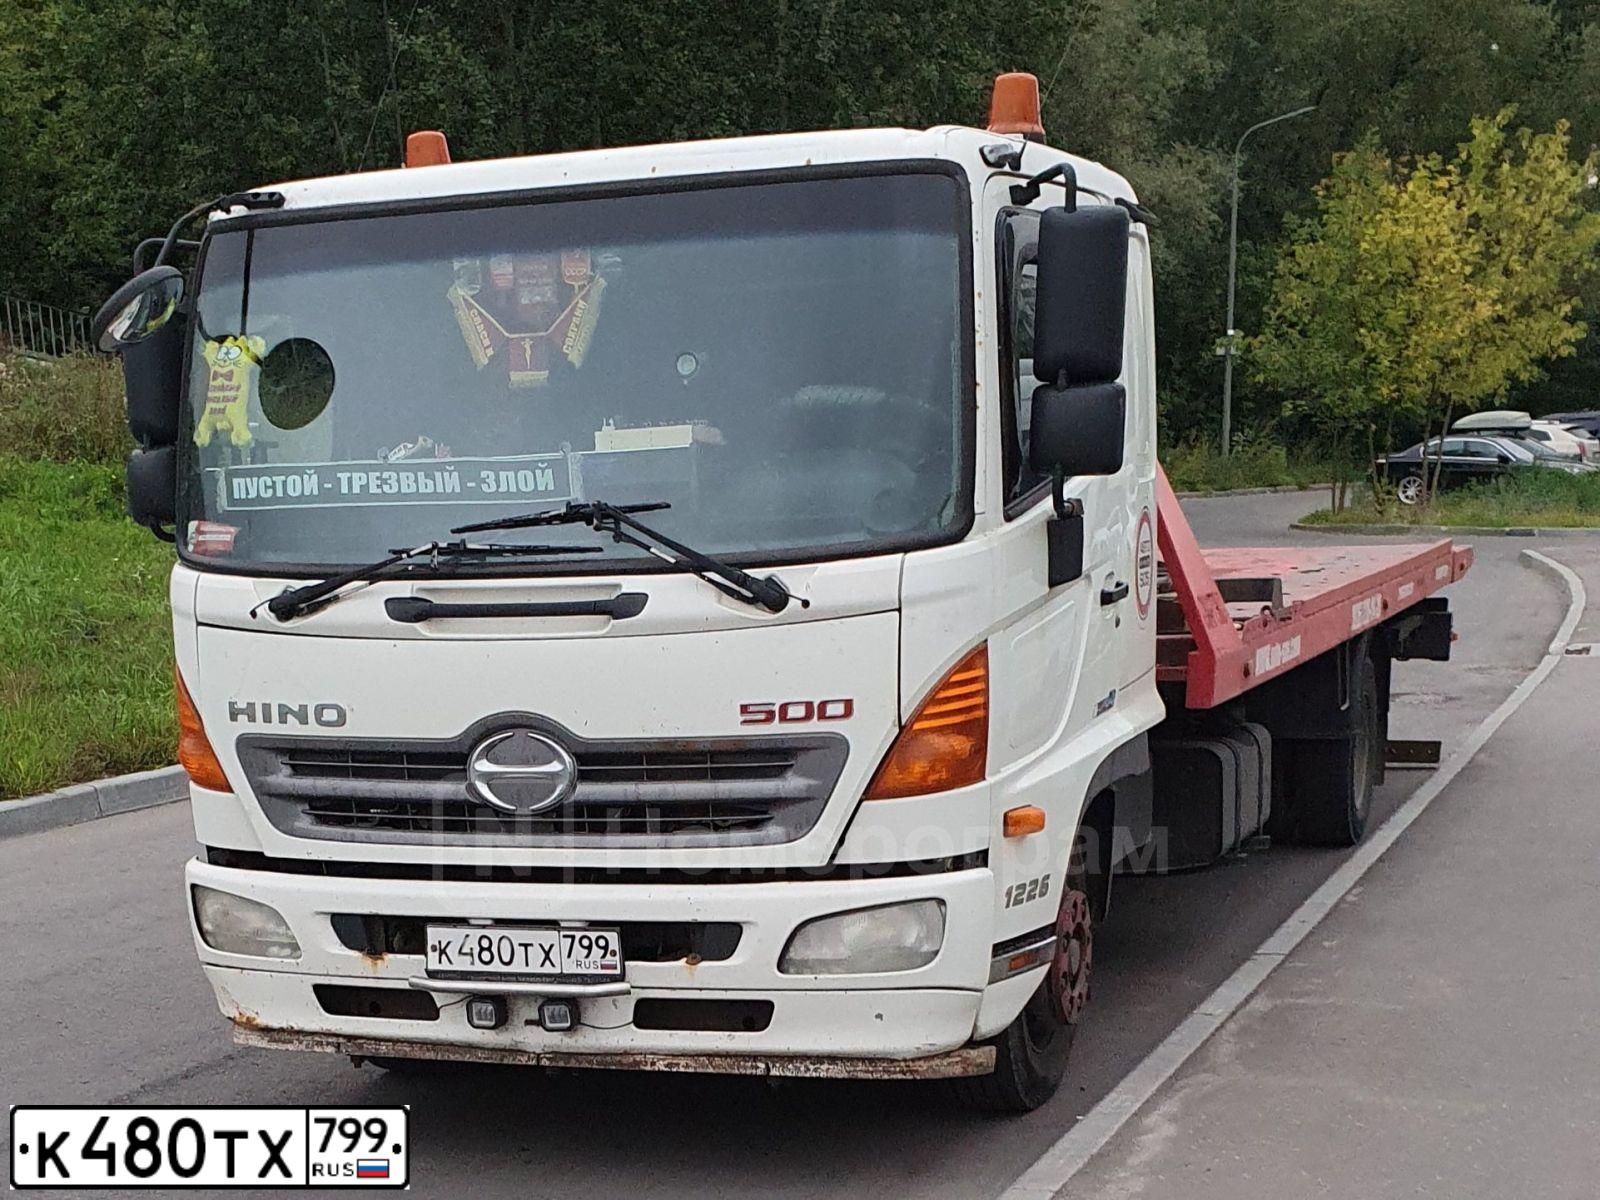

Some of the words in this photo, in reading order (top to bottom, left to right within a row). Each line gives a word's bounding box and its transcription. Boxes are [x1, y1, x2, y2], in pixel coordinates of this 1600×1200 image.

[232, 469, 319, 499] ПУСТОЙ
[336, 465, 461, 494] ТРЕЗВЫЙ
[480, 462, 555, 492] ЗЛОЙ
[228, 701, 347, 728] HINO
[739, 699, 854, 726] 500
[1004, 873, 1051, 909] 1226
[562, 934, 610, 960] 799
[575, 960, 599, 970] RUS
